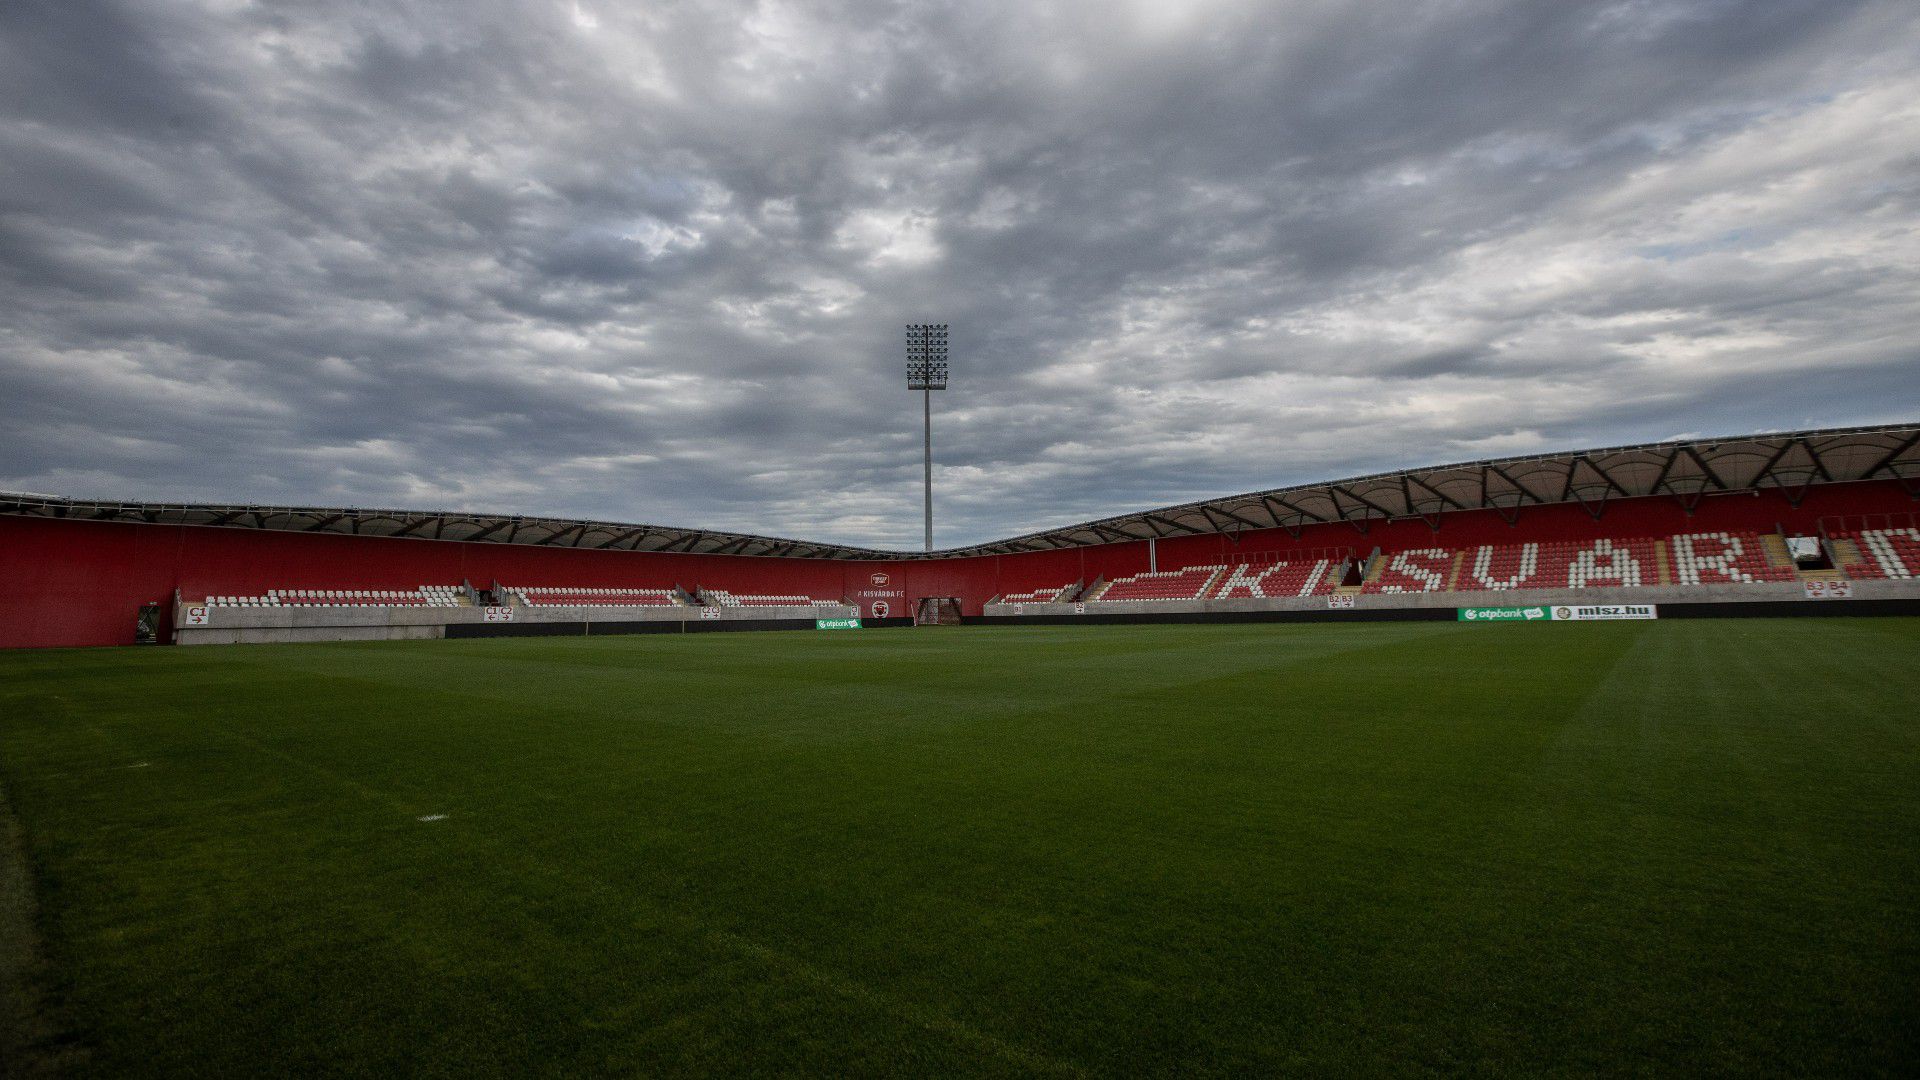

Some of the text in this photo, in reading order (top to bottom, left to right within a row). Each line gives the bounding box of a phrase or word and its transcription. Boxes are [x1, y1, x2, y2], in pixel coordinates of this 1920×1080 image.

[1829, 582, 1848, 590] B4
[190, 607, 206, 616] C1
[1479, 608, 1523, 620] otpbank
[1578, 606, 1650, 615] mlsz.hu
